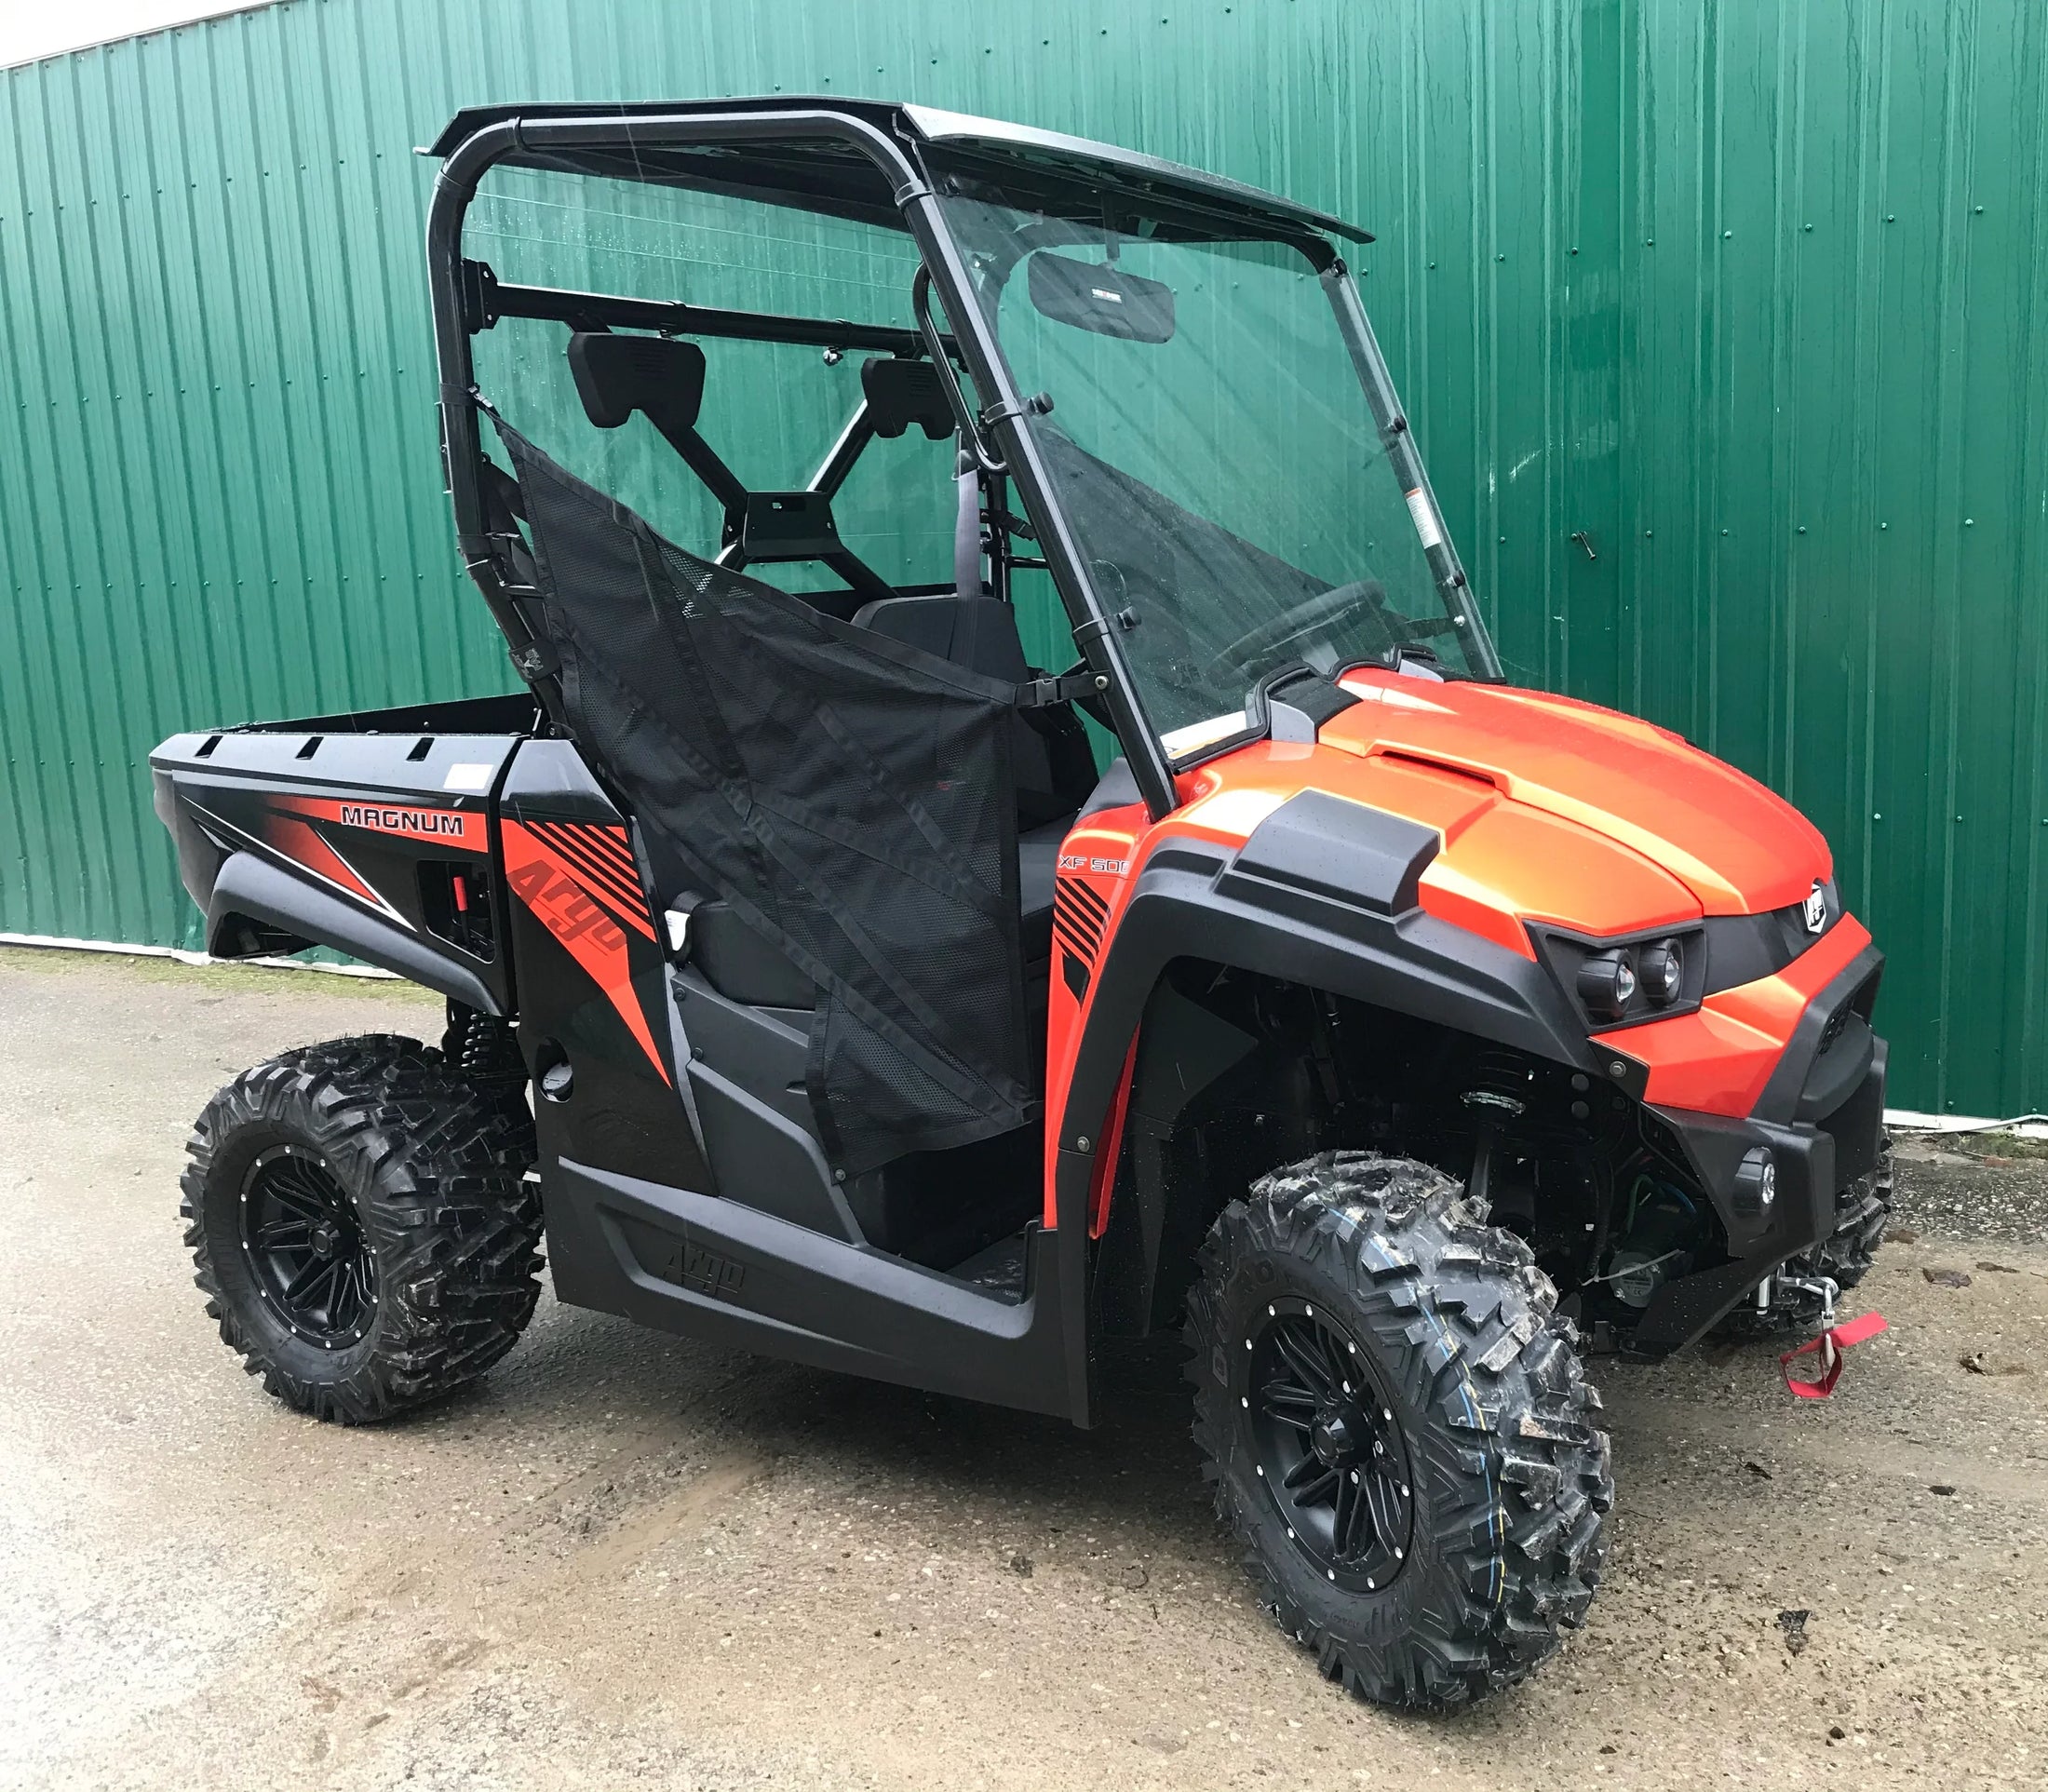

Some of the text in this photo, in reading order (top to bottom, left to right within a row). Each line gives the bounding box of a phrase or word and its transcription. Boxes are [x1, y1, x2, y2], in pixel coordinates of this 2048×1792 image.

[341, 805, 464, 836] MAGNUM
[1058, 856, 1086, 869] XF
[506, 859, 627, 951] Argo
[662, 1241, 745, 1295] Argo
